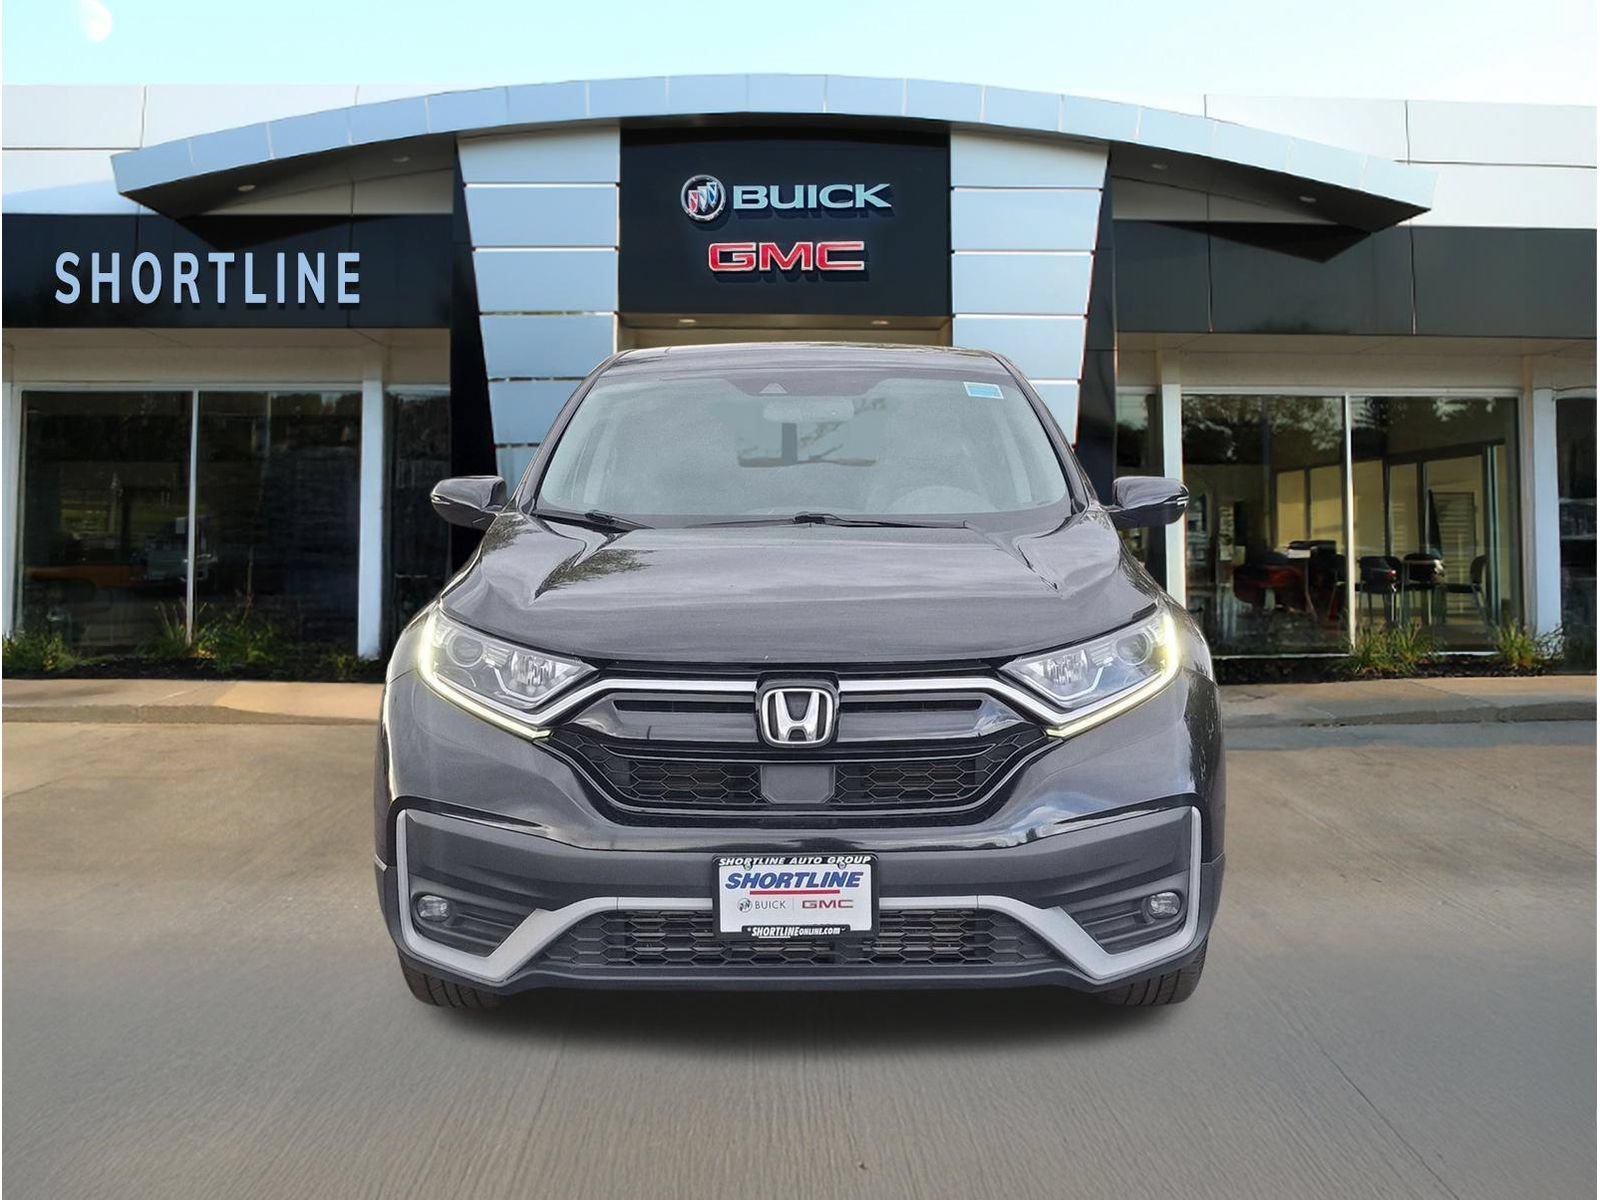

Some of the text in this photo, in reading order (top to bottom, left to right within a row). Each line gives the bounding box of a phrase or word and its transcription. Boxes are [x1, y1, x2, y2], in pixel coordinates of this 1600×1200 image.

[733, 183, 892, 209] BUICK
[708, 241, 865, 271] GMC
[55, 252, 360, 304] SHORTLINE
[719, 857, 786, 866] SHORTLINE
[827, 856, 871, 864] GROUP
[725, 871, 864, 889] SHORTLINE
[755, 901, 786, 909] BUICK
[802, 900, 853, 909] GMC
